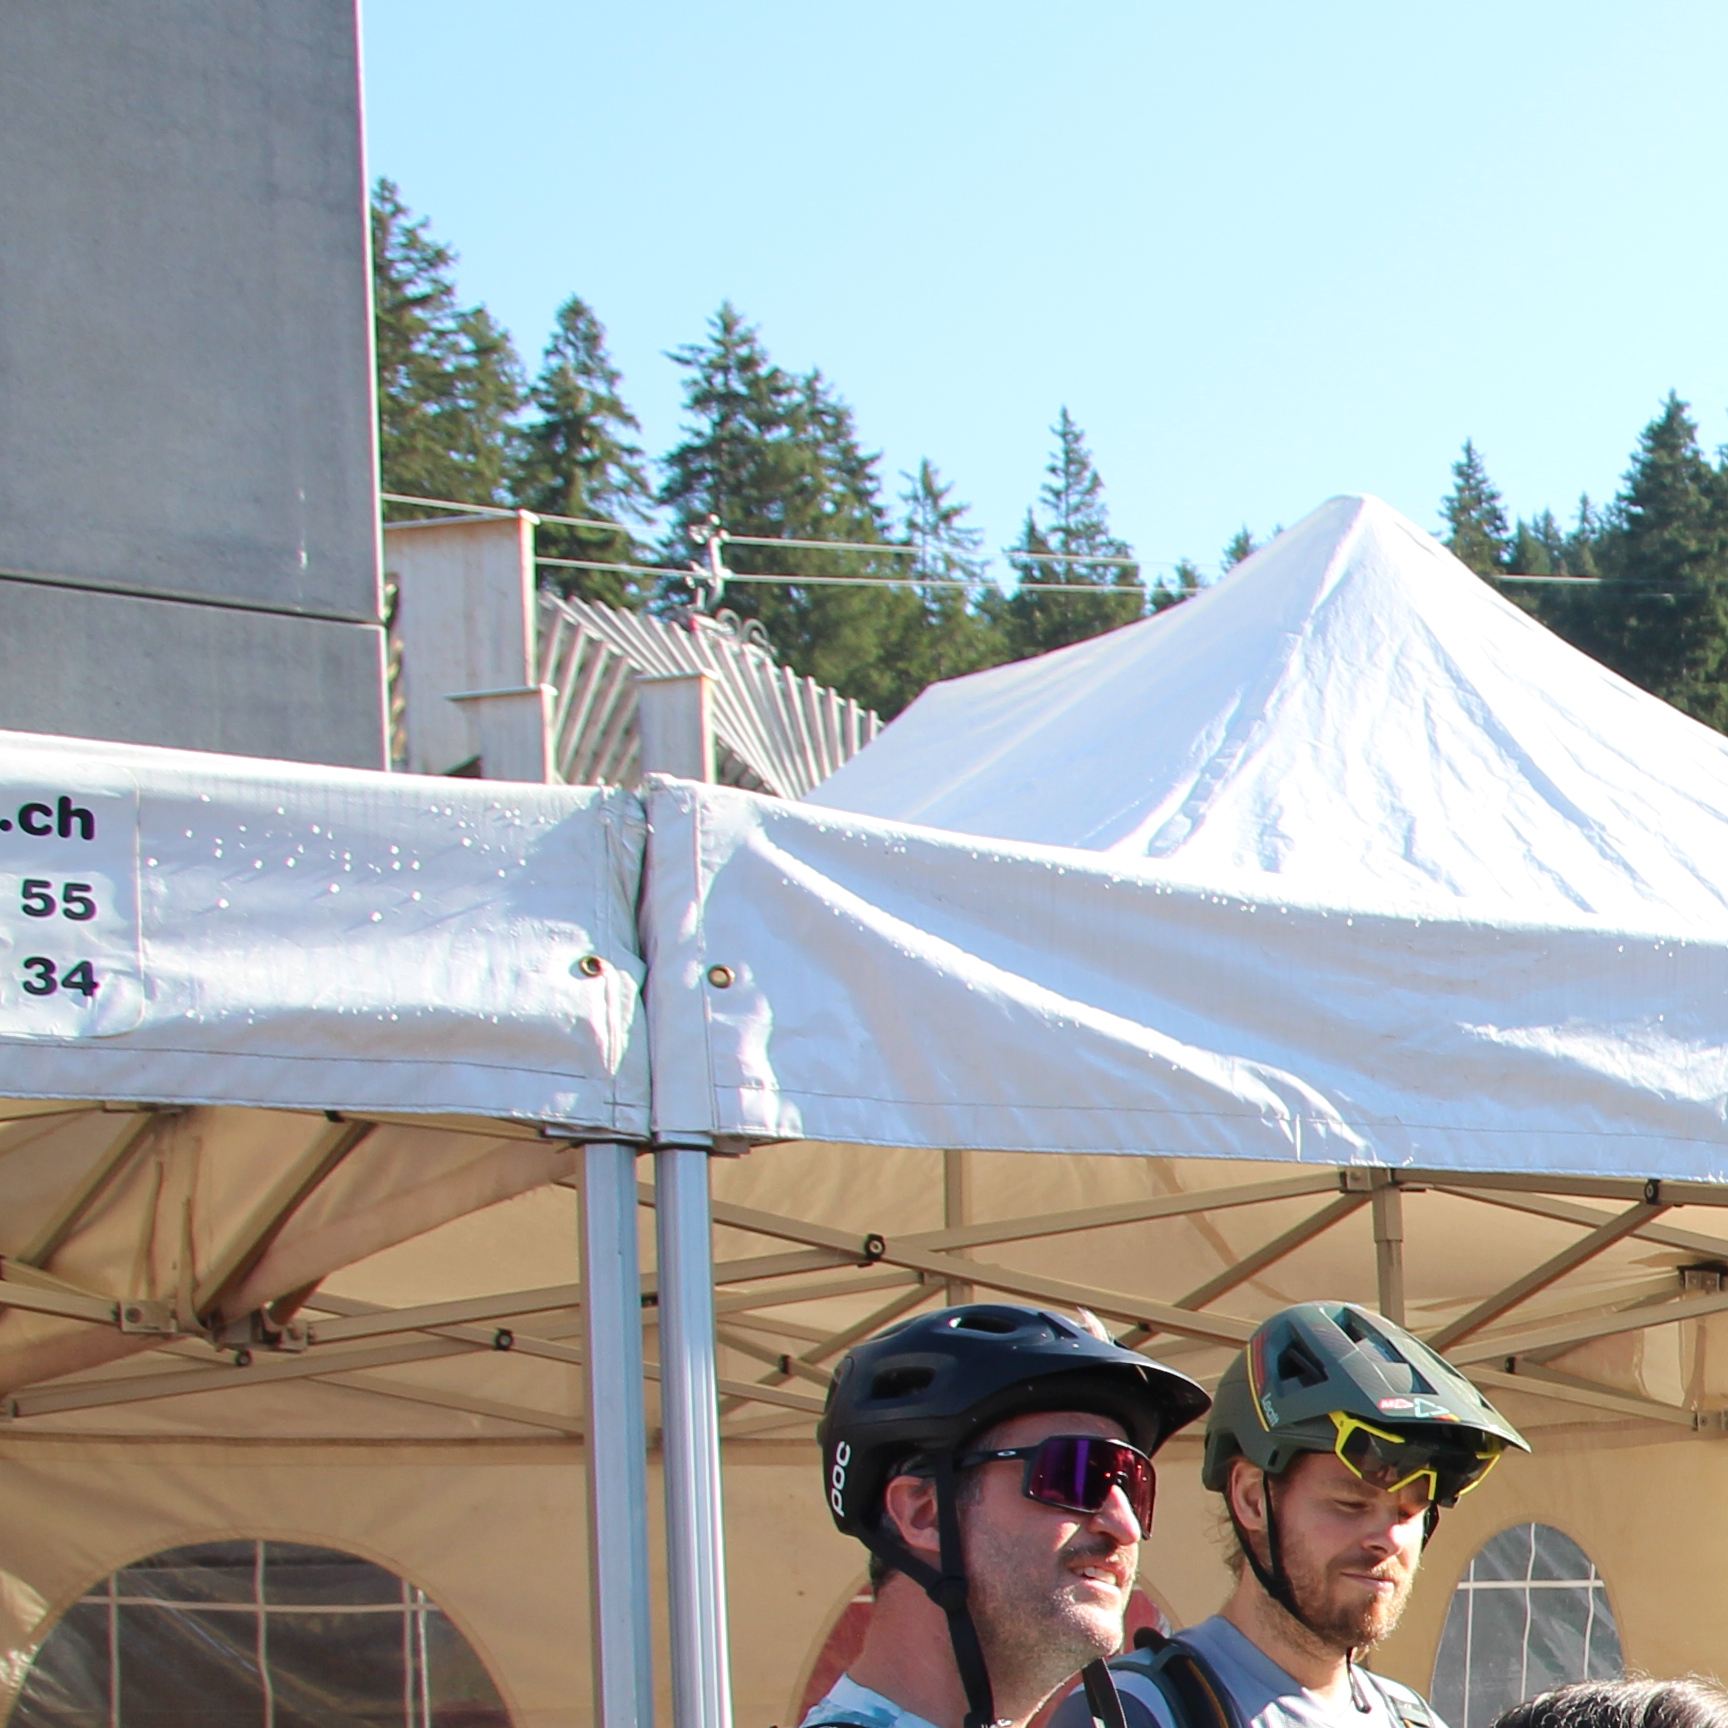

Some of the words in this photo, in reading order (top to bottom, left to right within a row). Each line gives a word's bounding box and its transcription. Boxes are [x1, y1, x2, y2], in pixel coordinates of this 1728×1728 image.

[21, 878, 98, 922] 55
[22, 956, 101, 997] 34
[831, 1441, 851, 1517] POC
